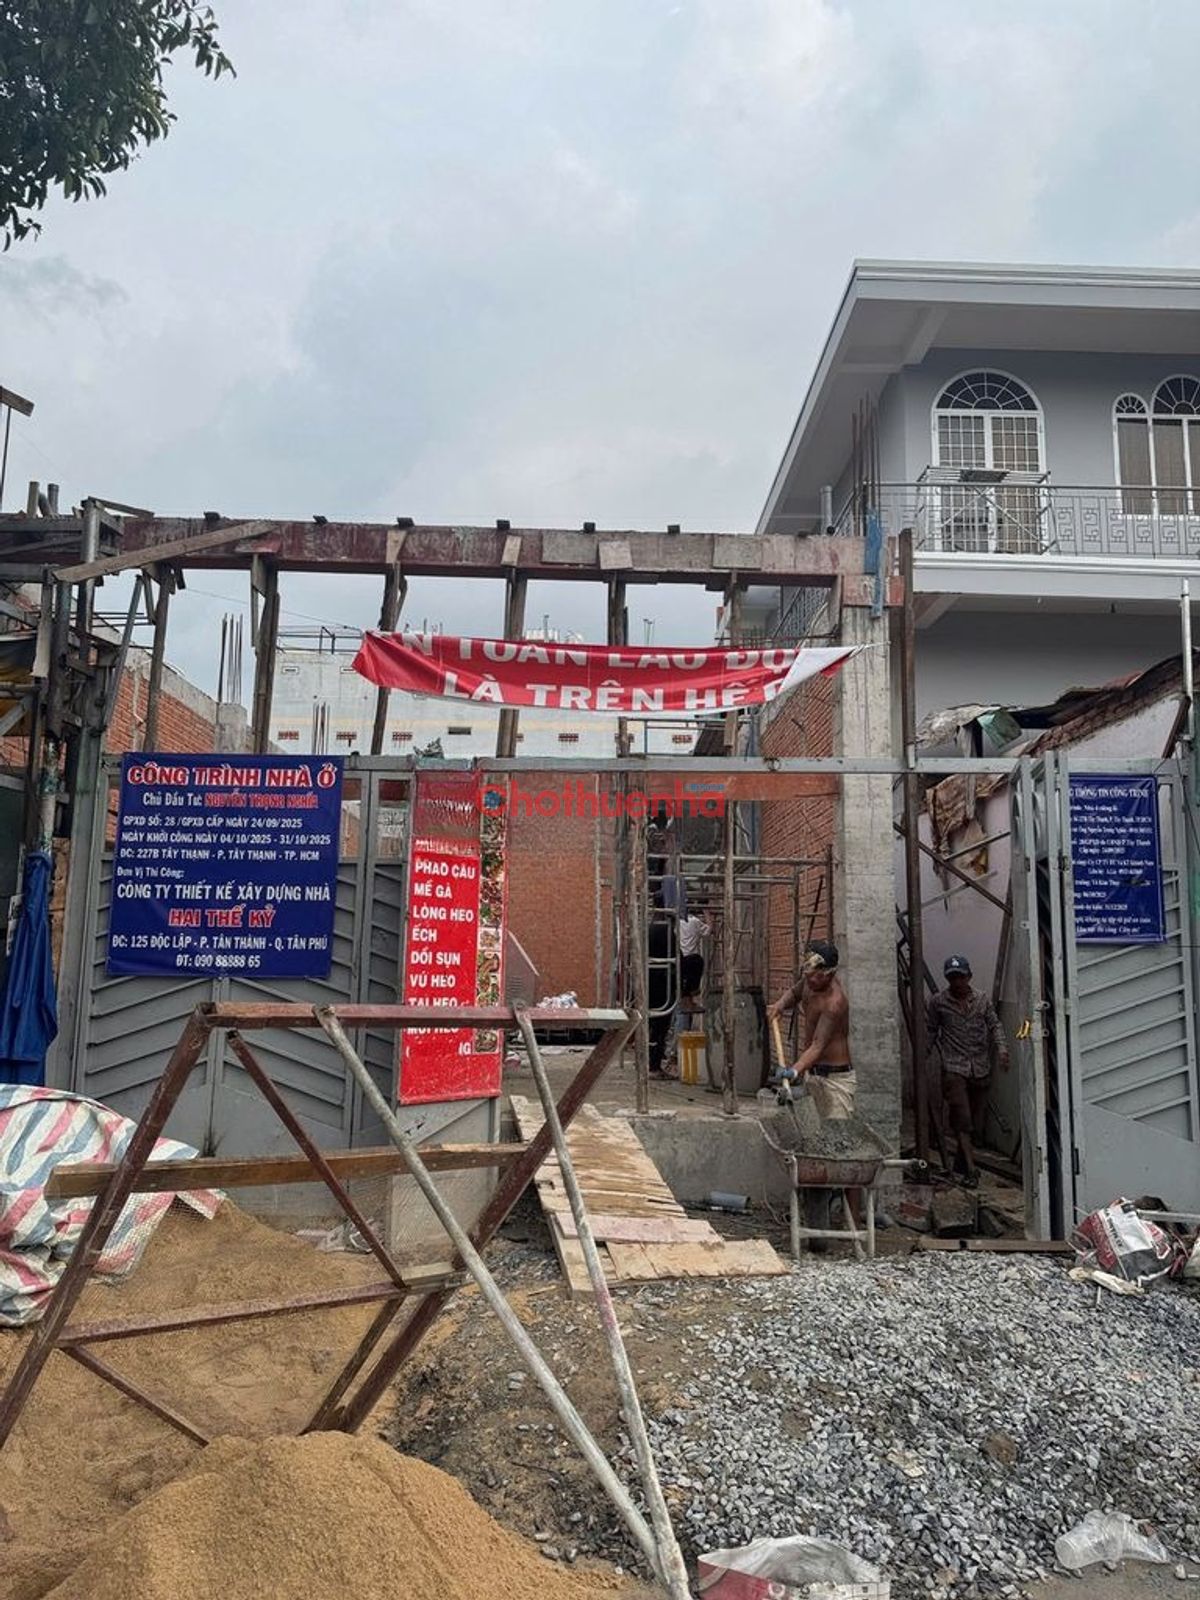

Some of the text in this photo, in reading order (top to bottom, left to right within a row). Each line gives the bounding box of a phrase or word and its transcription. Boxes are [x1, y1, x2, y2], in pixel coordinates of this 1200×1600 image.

[442, 671, 505, 703] LÀ
[525, 679, 664, 711] TRÊN
[127, 761, 338, 788] CÔNG TRÌNH NHÀ Ở
[226, 815, 249, 829] NGÀY
[121, 830, 144, 842] NGÀY
[170, 831, 193, 843] CÔNG
[195, 831, 218, 844] NGÀY
[162, 846, 180, 859] TÂY
[181, 849, 210, 861] THẠNH
[228, 848, 245, 861] TÂY
[247, 850, 276, 862] THẠNH
[300, 851, 320, 861] HCM
[415, 860, 449, 876] PHAO
[117, 879, 330, 903] CÔNG TY THIẾT KẾ XÂY DỰNG NHÀ
[435, 882, 453, 899] GÀ
[168, 908, 201, 927] HAI
[205, 903, 246, 928] THẾ
[413, 902, 474, 922] LÒNG HEO
[412, 923, 438, 942] ẾCH
[130, 935, 148, 949] 125
[150, 933, 170, 951] ĐỘC
[172, 933, 192, 951] LẬP
[200, 936, 209, 949] P.
[212, 933, 231, 950] TÂN
[274, 936, 284, 951] Q.
[287, 934, 306, 950] TÂN
[308, 934, 328, 950] PHÚ
[248, 955, 261, 968] 65
[435, 951, 461, 968] SỤN
[410, 970, 456, 988] VÚ HEO
